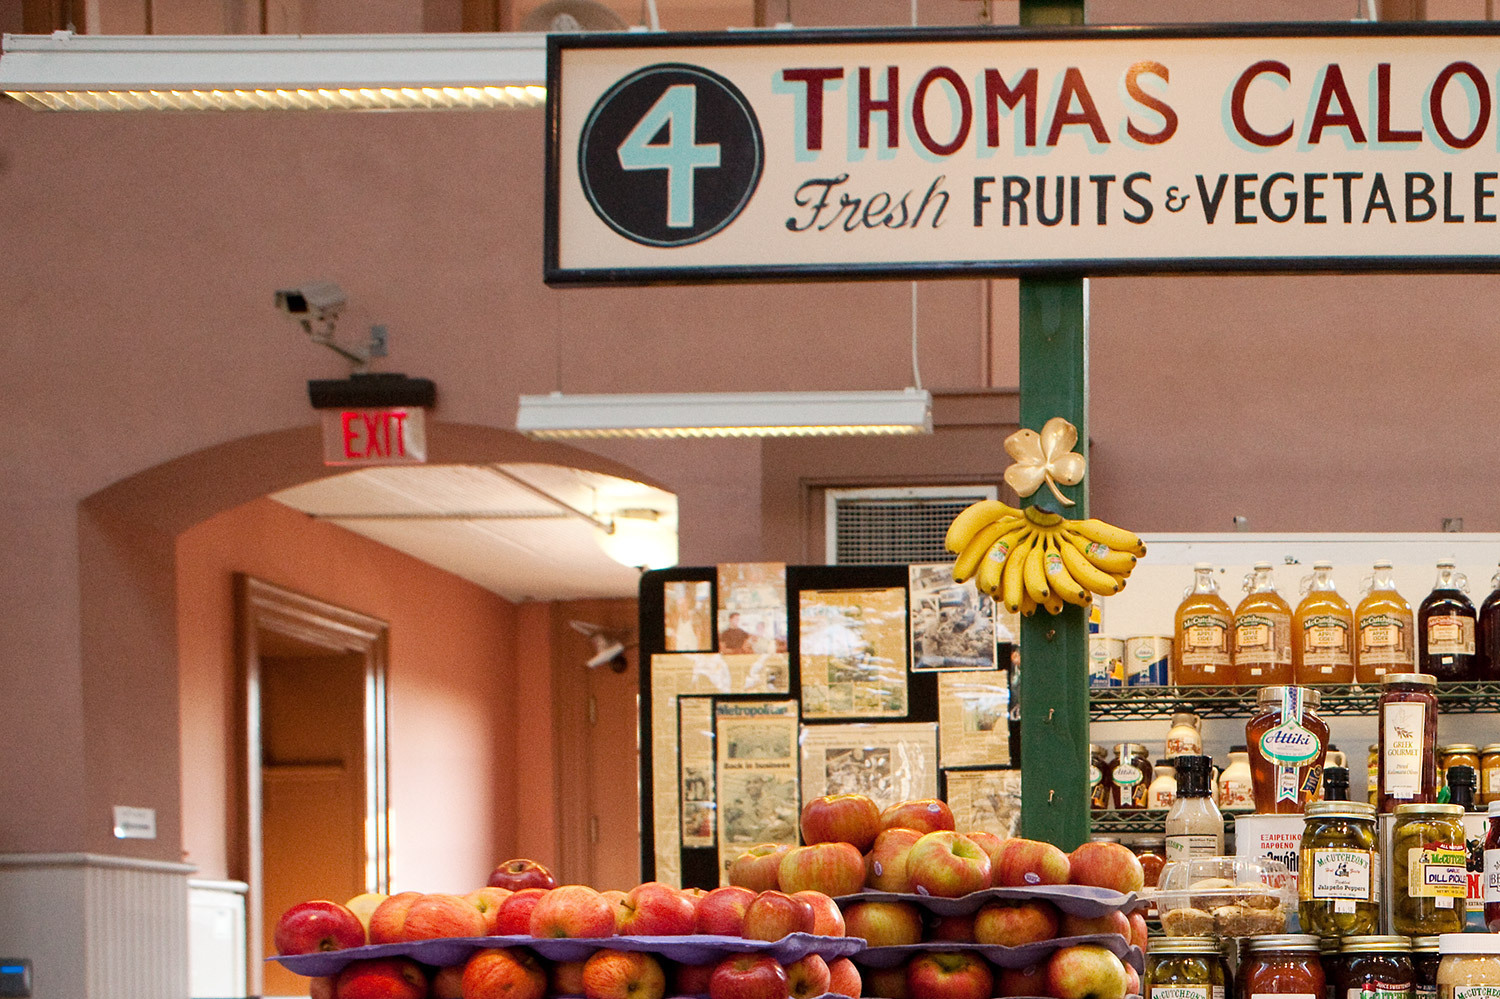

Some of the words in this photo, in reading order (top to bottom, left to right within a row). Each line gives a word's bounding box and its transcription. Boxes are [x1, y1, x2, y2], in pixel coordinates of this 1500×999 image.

[780, 61, 1179, 157] THOMAS
[616, 83, 723, 229] 4
[785, 173, 950, 233] Fresh
[972, 172, 1154, 227] FRUITS
[1164, 185, 1190, 213] &
[341, 411, 409, 459] EXIT
[1266, 730, 1311, 745] Attiki
[1387, 748, 1418, 756] GOURMET
[1393, 741, 1413, 749] GREEK
[1429, 874, 1447, 883] DILL
